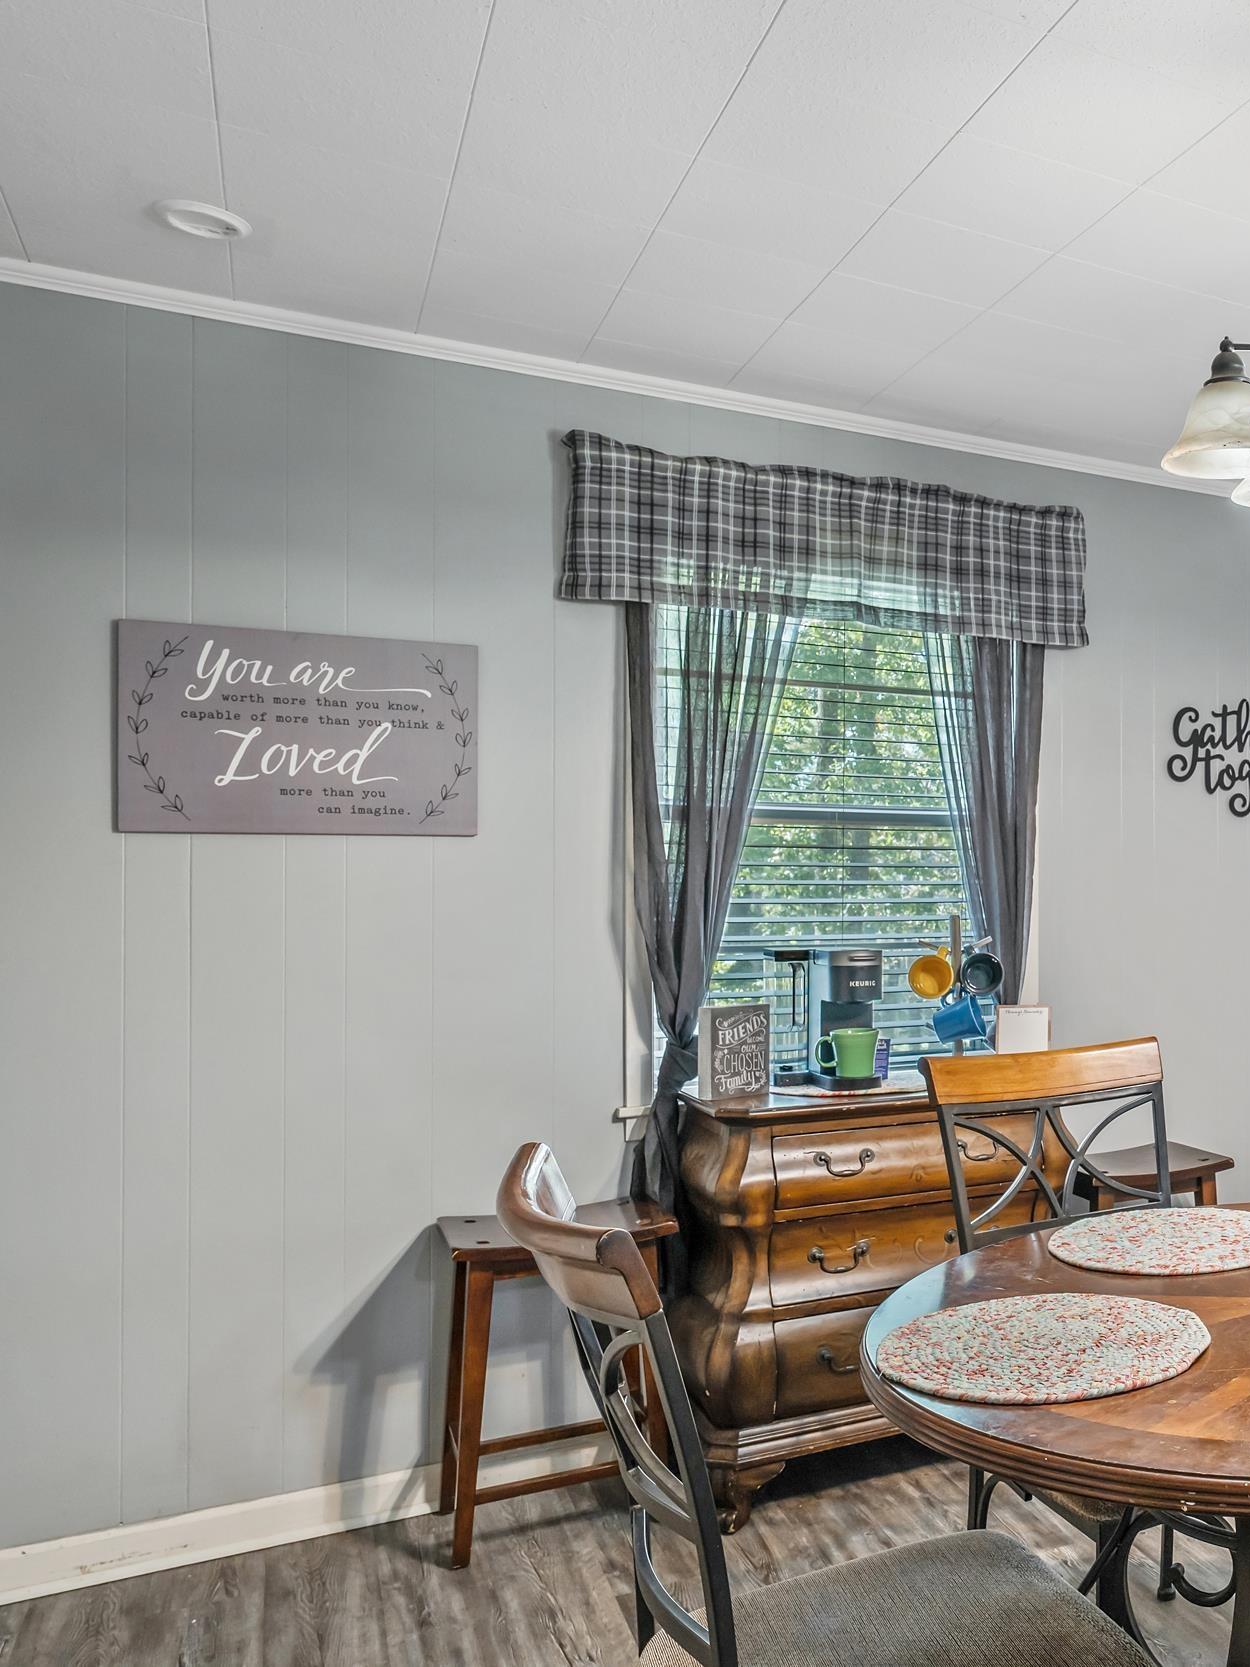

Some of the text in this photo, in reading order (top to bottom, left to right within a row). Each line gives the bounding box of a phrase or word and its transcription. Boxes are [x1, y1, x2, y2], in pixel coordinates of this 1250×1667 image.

[289, 661, 432, 698] are
[221, 693, 425, 713] worth more than you know,
[180, 709, 446, 731] capable of more than you think &
[214, 721, 400, 787] Loved
[279, 786, 387, 801] more than you
[316, 804, 412, 818] can imagine.
[717, 1013, 768, 1046] FRIENDS
[723, 1050, 766, 1074] CHOSEN
[714, 1069, 762, 1095] Family
